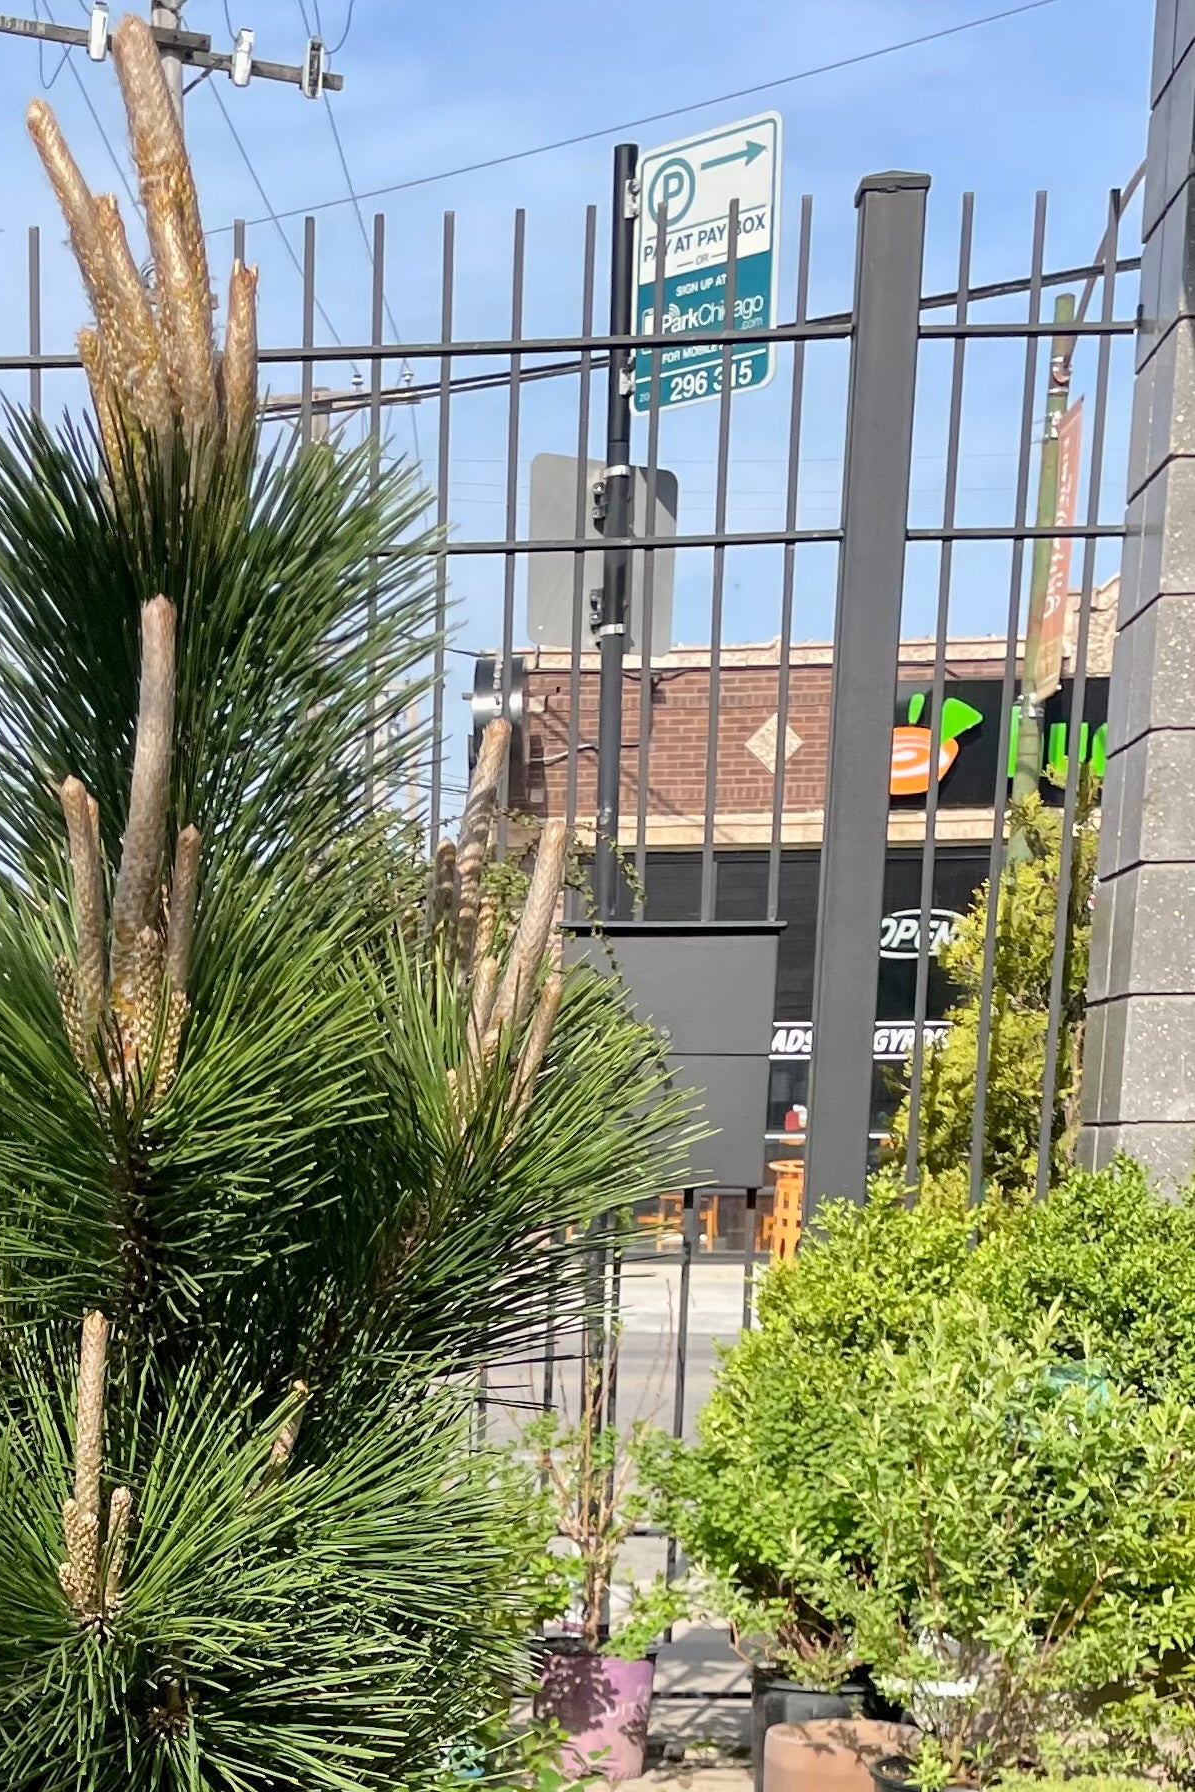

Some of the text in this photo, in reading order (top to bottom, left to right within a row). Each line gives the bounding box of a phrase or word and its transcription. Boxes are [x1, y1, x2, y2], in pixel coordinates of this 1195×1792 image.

[643, 239, 672, 263] PY
[674, 233, 693, 254] AT
[698, 224, 726, 247] PAY
[676, 273, 727, 297] SIGN UP AT
[662, 295, 764, 334] ParkChiago
[662, 350, 680, 364] FOR
[670, 370, 708, 401] 296
